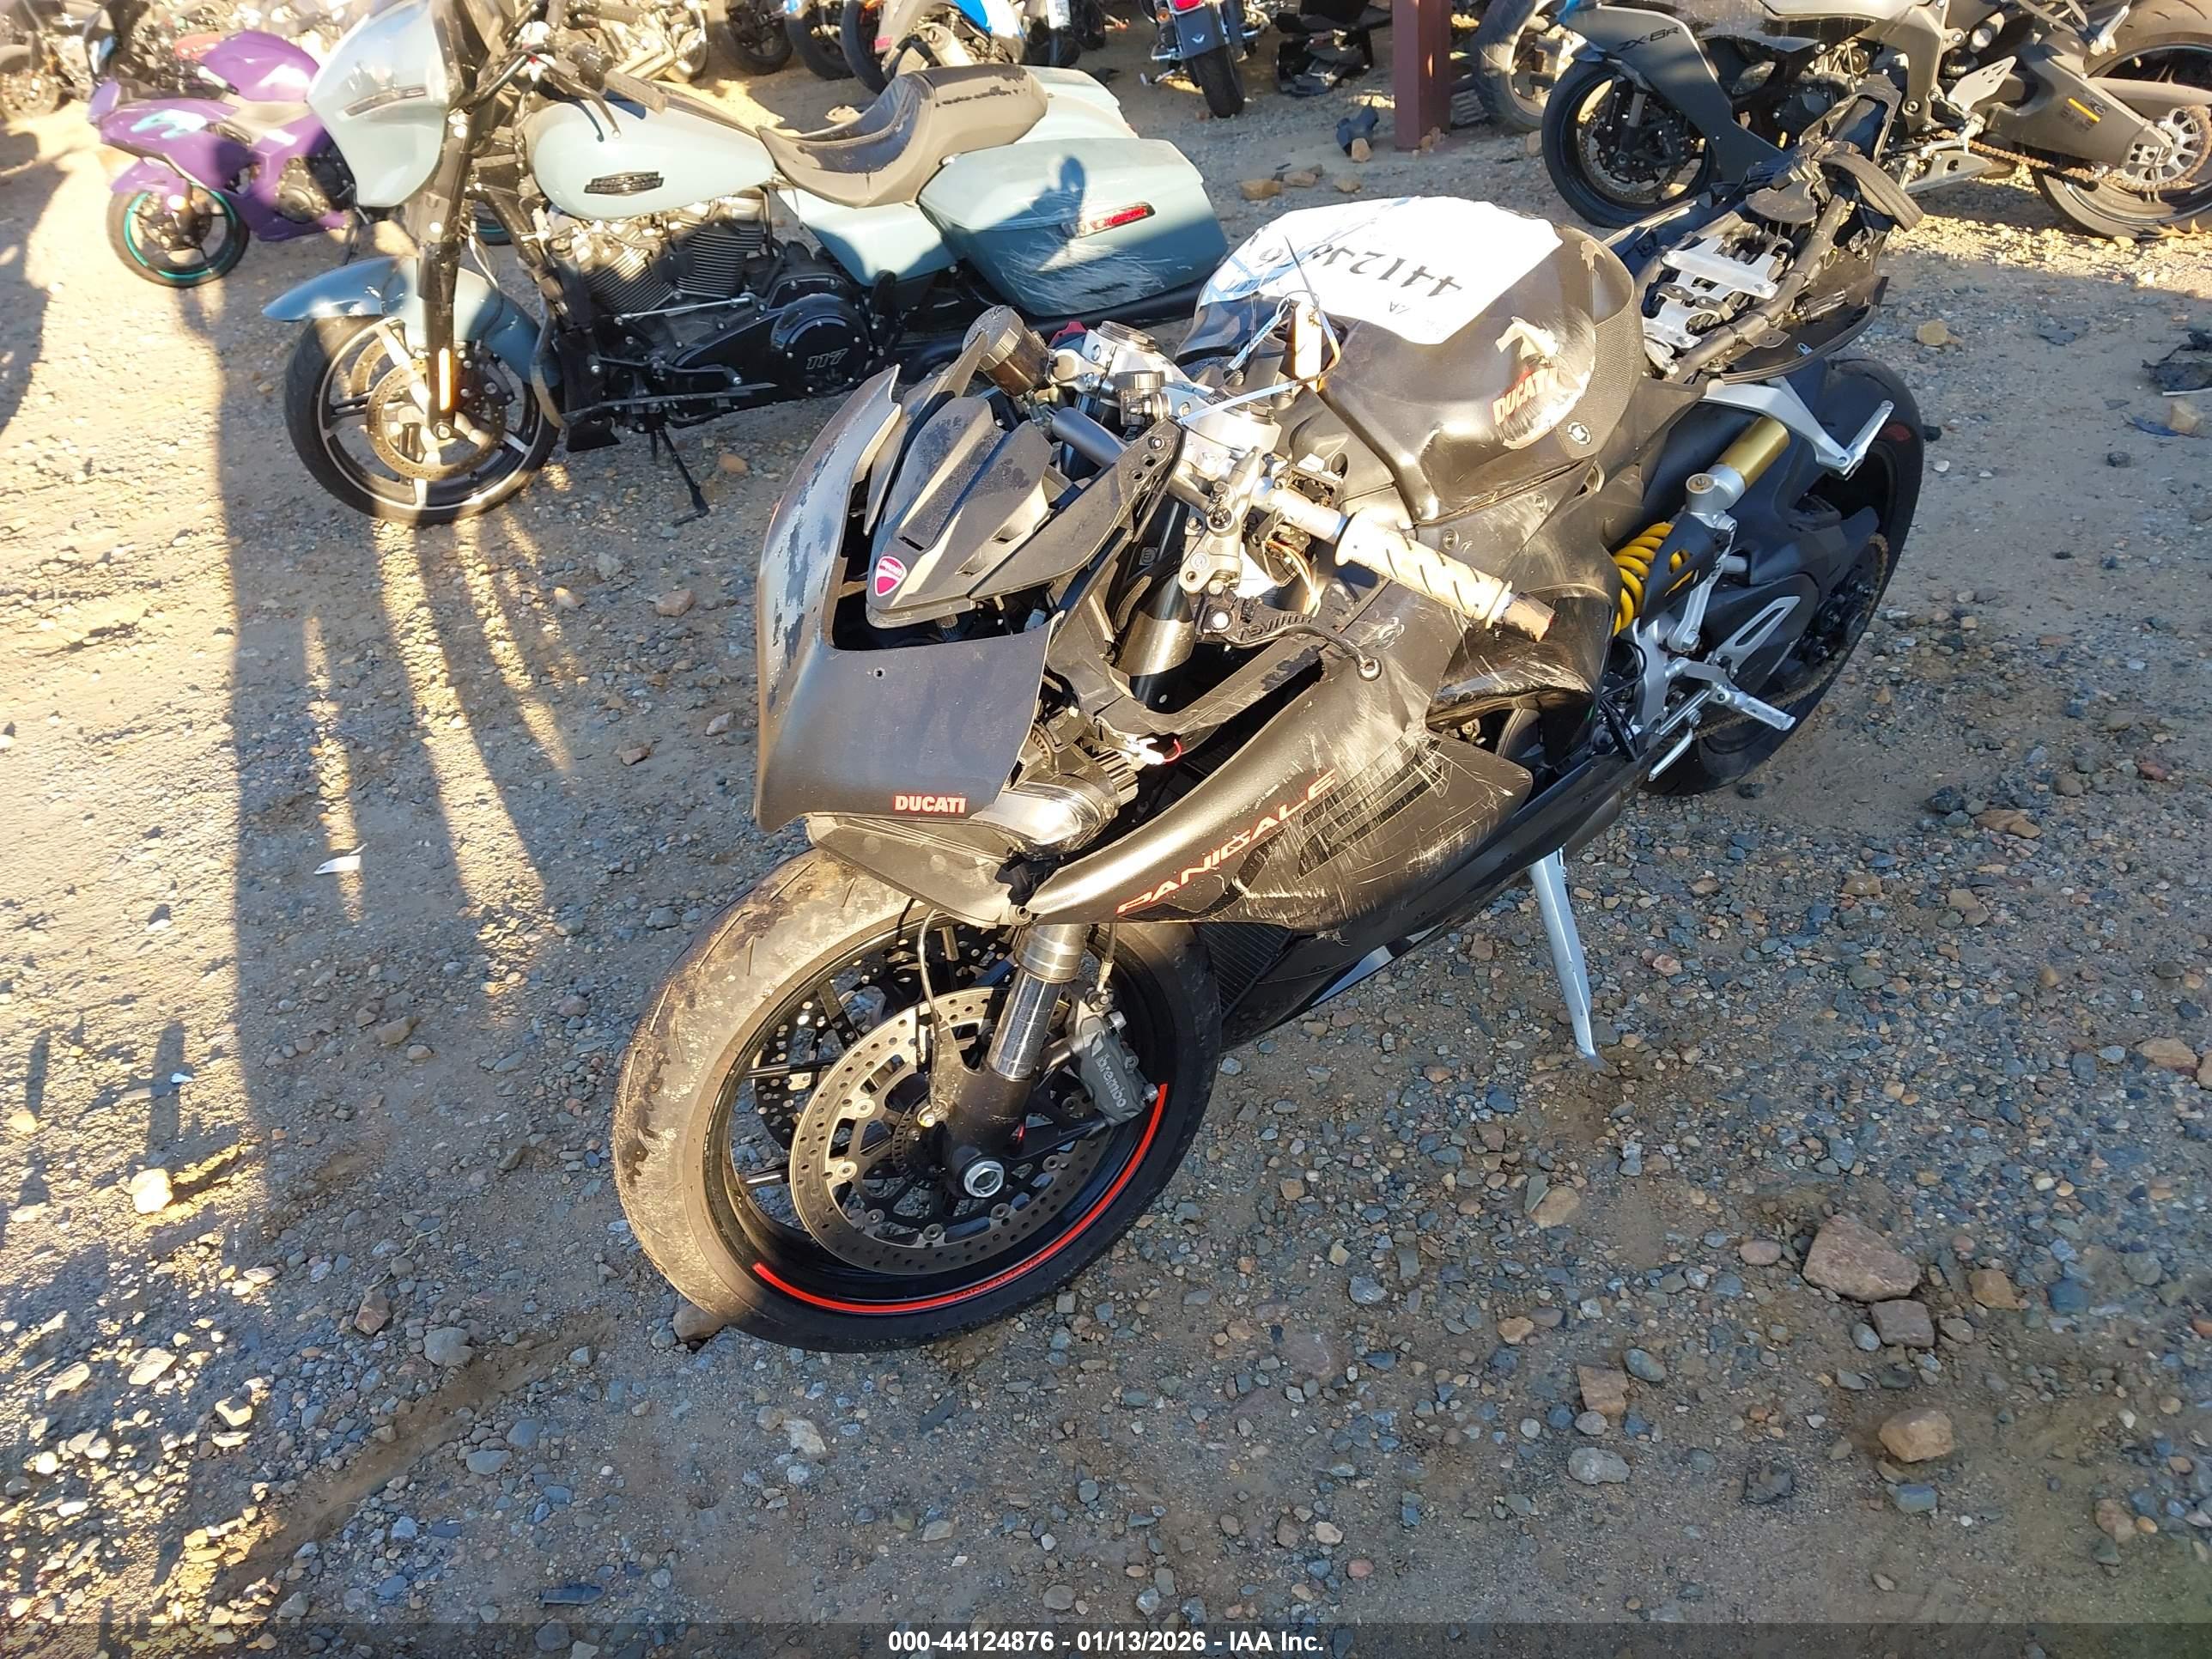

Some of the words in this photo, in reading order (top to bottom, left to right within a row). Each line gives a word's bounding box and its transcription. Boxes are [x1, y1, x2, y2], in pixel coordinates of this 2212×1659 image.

[1617, 27, 1680, 52] ZX-6R
[894, 795, 967, 814] DUCATI
[1116, 768, 1336, 915] PANIGALE
[1095, 1052, 1127, 1109] brembo
